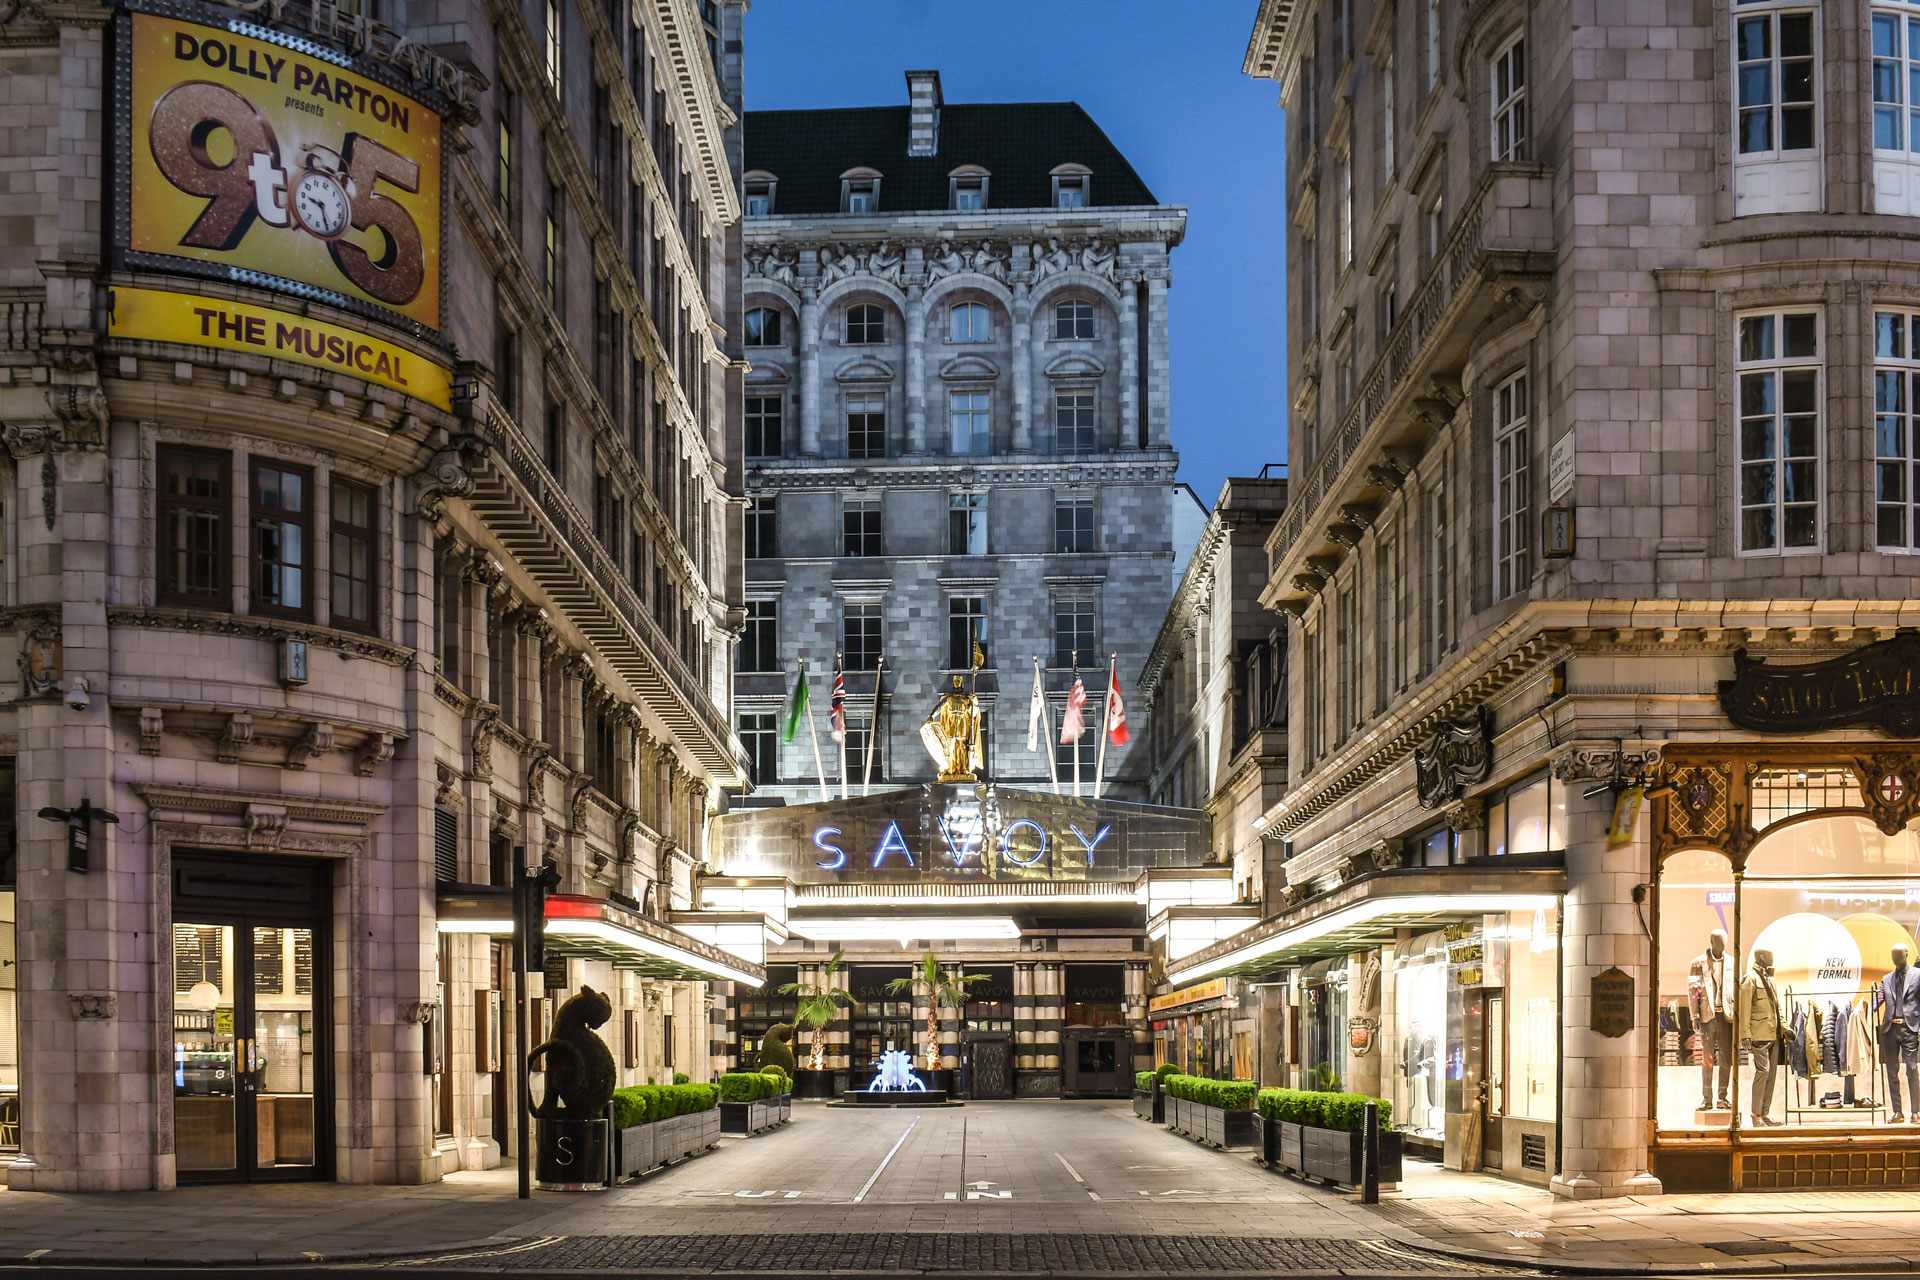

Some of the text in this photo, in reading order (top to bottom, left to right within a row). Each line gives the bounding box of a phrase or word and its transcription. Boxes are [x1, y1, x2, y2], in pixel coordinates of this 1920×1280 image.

[174, 31, 410, 134] DOLLY PARTON
[284, 96, 325, 118] presents
[148, 79, 281, 252] 9
[328, 131, 427, 306] 5
[193, 307, 408, 386] THE MUSICAL
[1554, 511, 1564, 550] TAXI
[813, 815, 1111, 869] SAVOY
[1816, 969, 1853, 980] FORMAL
[1825, 957, 1846, 967] NEW
[1073, 986, 1117, 998] SAVOY
[556, 1136, 573, 1166] S
[943, 1190, 1013, 1200] IN
